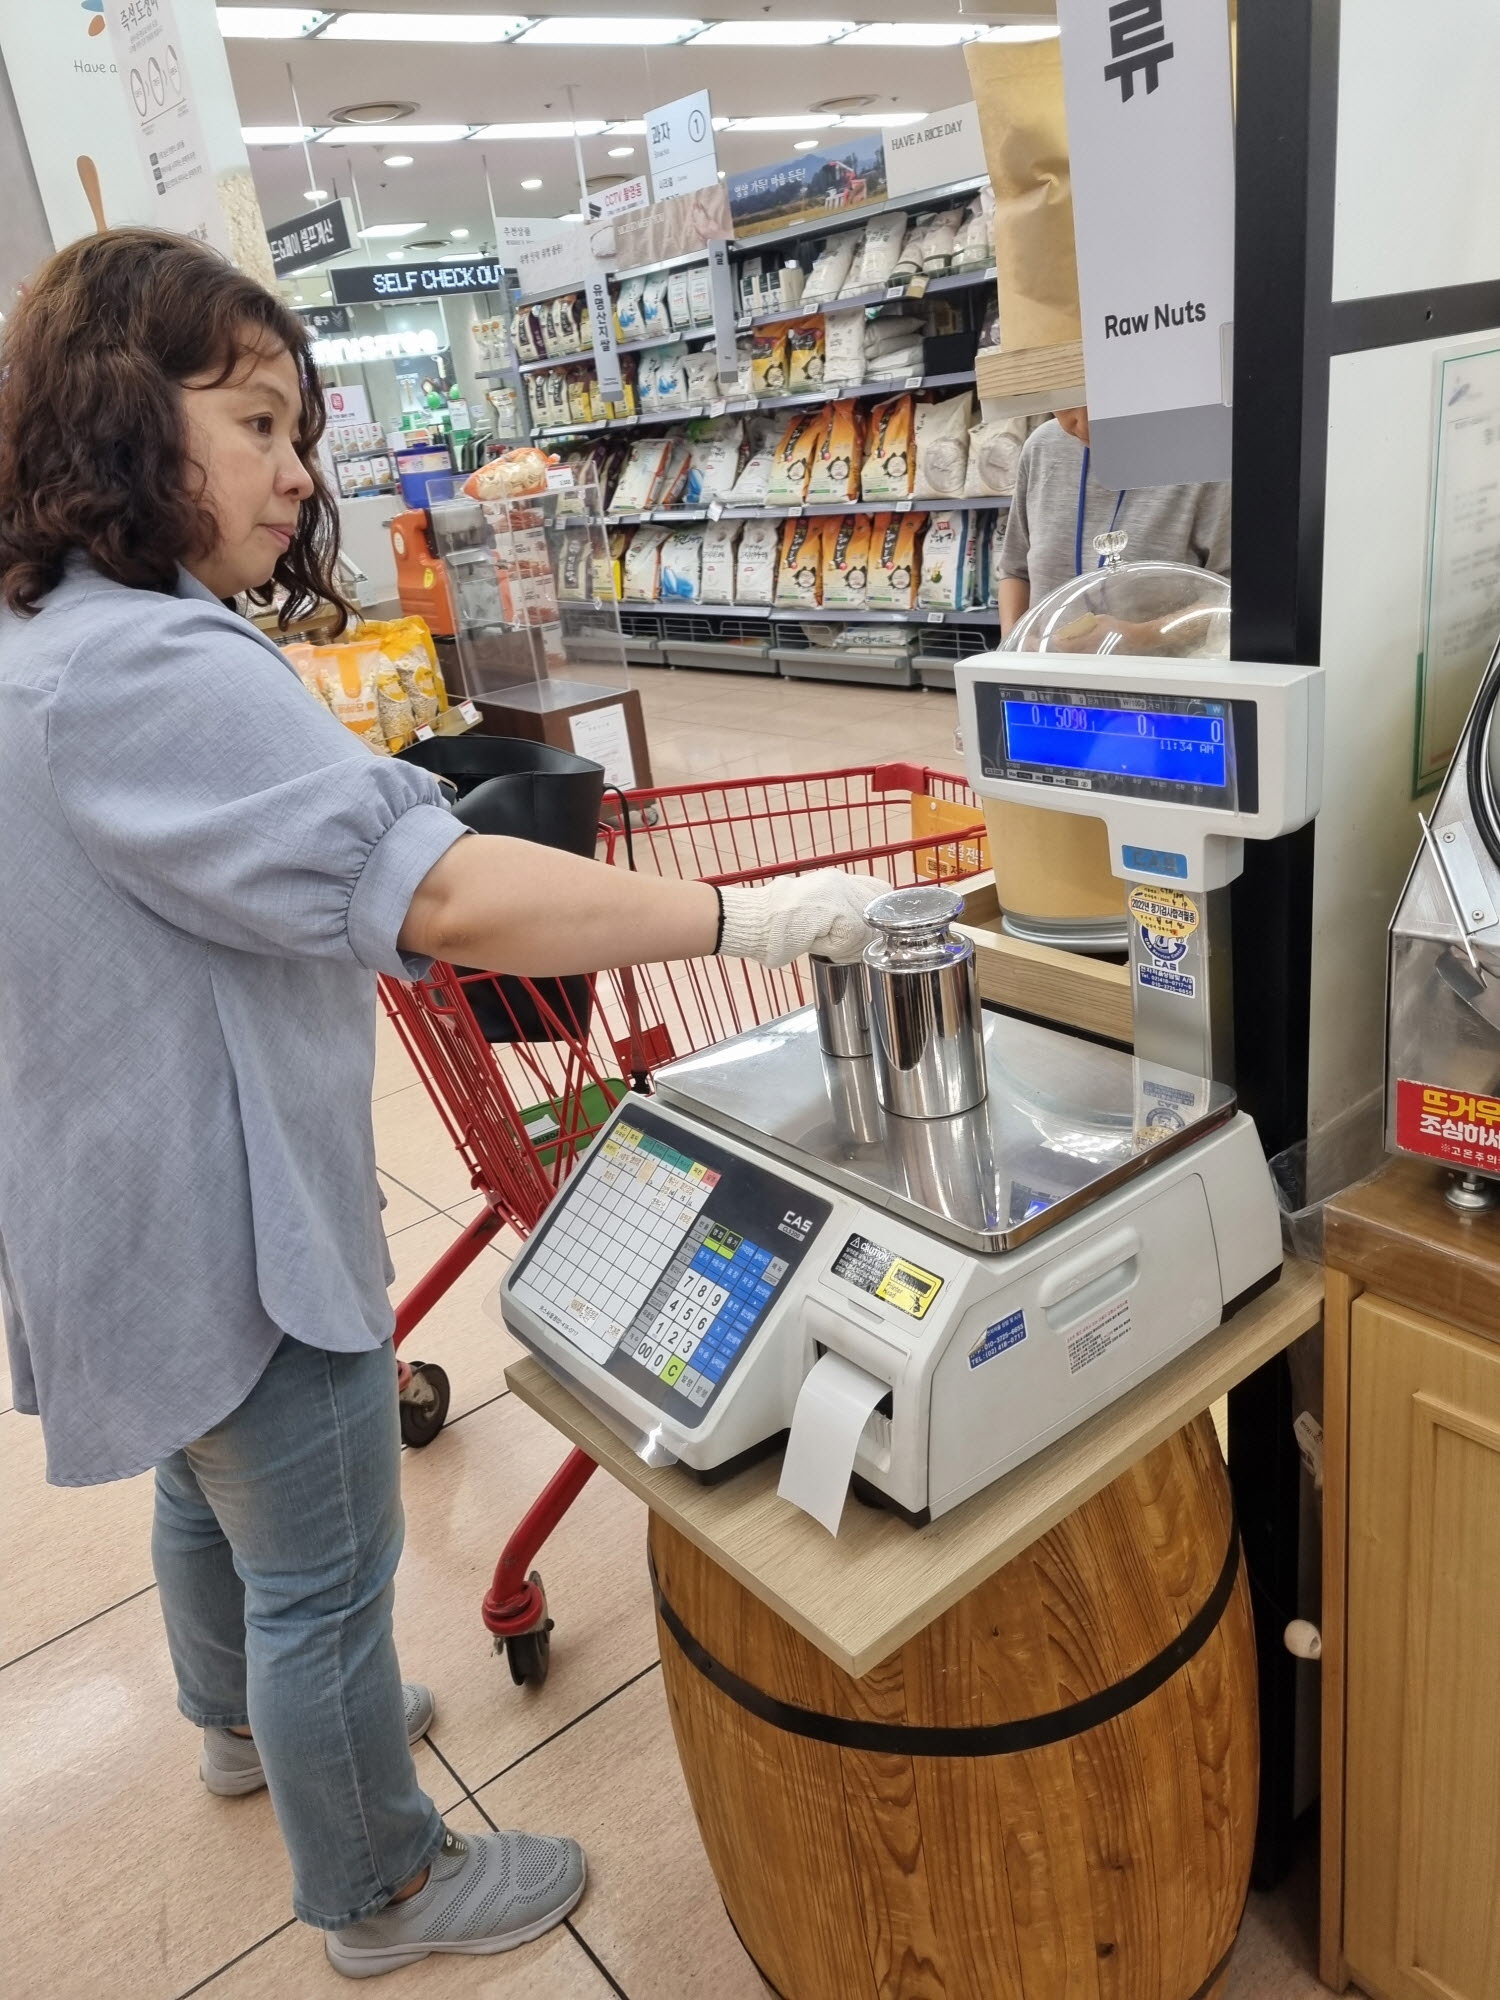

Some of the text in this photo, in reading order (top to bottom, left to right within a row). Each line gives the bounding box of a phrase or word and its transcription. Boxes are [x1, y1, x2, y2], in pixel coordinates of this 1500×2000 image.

[73, 59, 118, 73] Have a
[651, 121, 670, 145] 과자
[891, 119, 963, 151] HAVE A RICE DAY
[372, 271, 418, 294] SELF
[421, 266, 476, 290] CHECK
[1105, 300, 1206, 340] Raw Nuts
[1032, 705, 1041, 725] 0
[1137, 714, 1147, 736] 0
[1211, 720, 1221, 743] 0
[1154, 959, 1177, 972] CAS
[783, 1210, 814, 1233] CAS
[683, 1275, 695, 1288] 7
[697, 1284, 708, 1297] 8
[669, 1299, 679, 1312] 4
[711, 1293, 722, 1307] 9
[683, 1307, 694, 1321] 5
[655, 1321, 665, 1335] 1
[697, 1317, 708, 1331] 6
[667, 1331, 679, 1345] 2
[637, 1342, 653, 1359] 00
[682, 1340, 693, 1354] 3
[653, 1354, 664, 1368] 0
[667, 1364, 678, 1377] C
